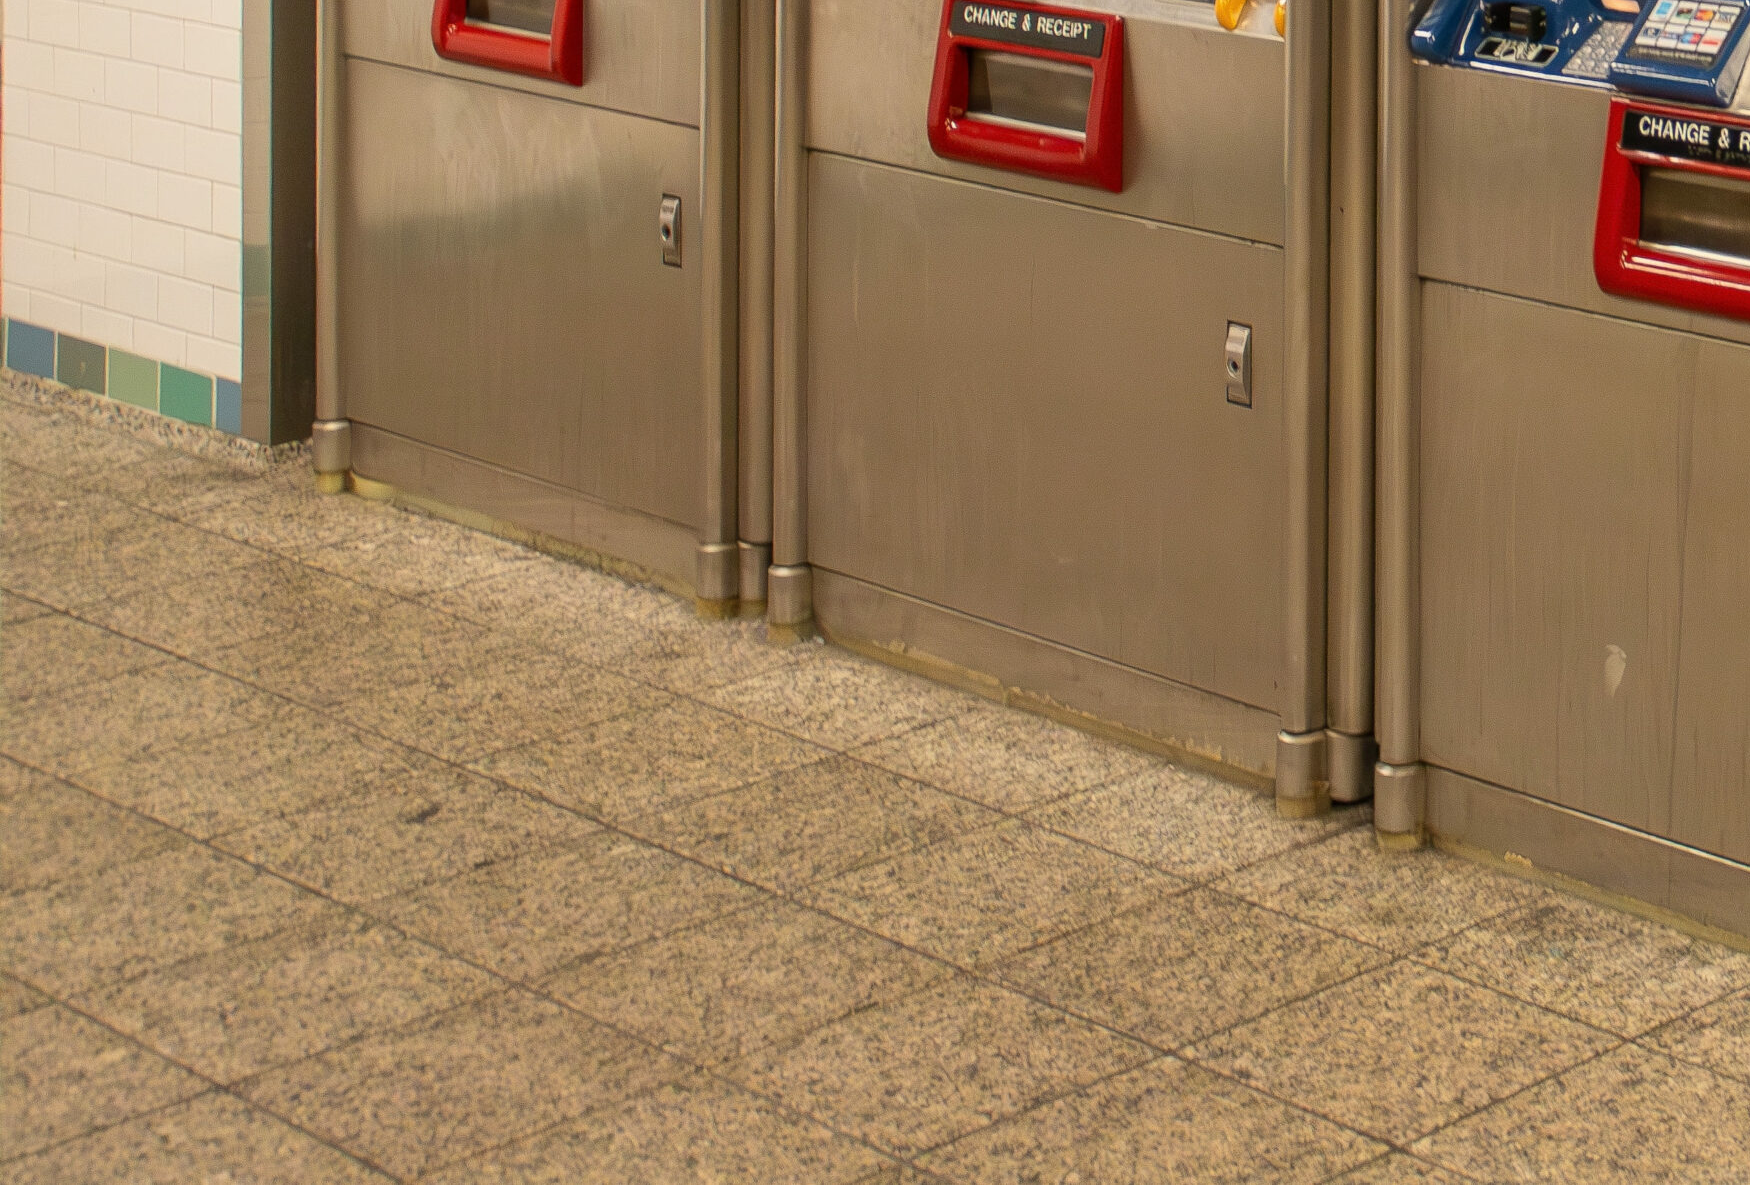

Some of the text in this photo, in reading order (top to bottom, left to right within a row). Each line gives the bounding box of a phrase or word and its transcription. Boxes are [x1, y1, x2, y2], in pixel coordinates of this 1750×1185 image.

[964, 5, 1092, 40] CHANGE & RECEIPT
[1639, 115, 1711, 146] CHANGE
[1718, 127, 1730, 149] &
